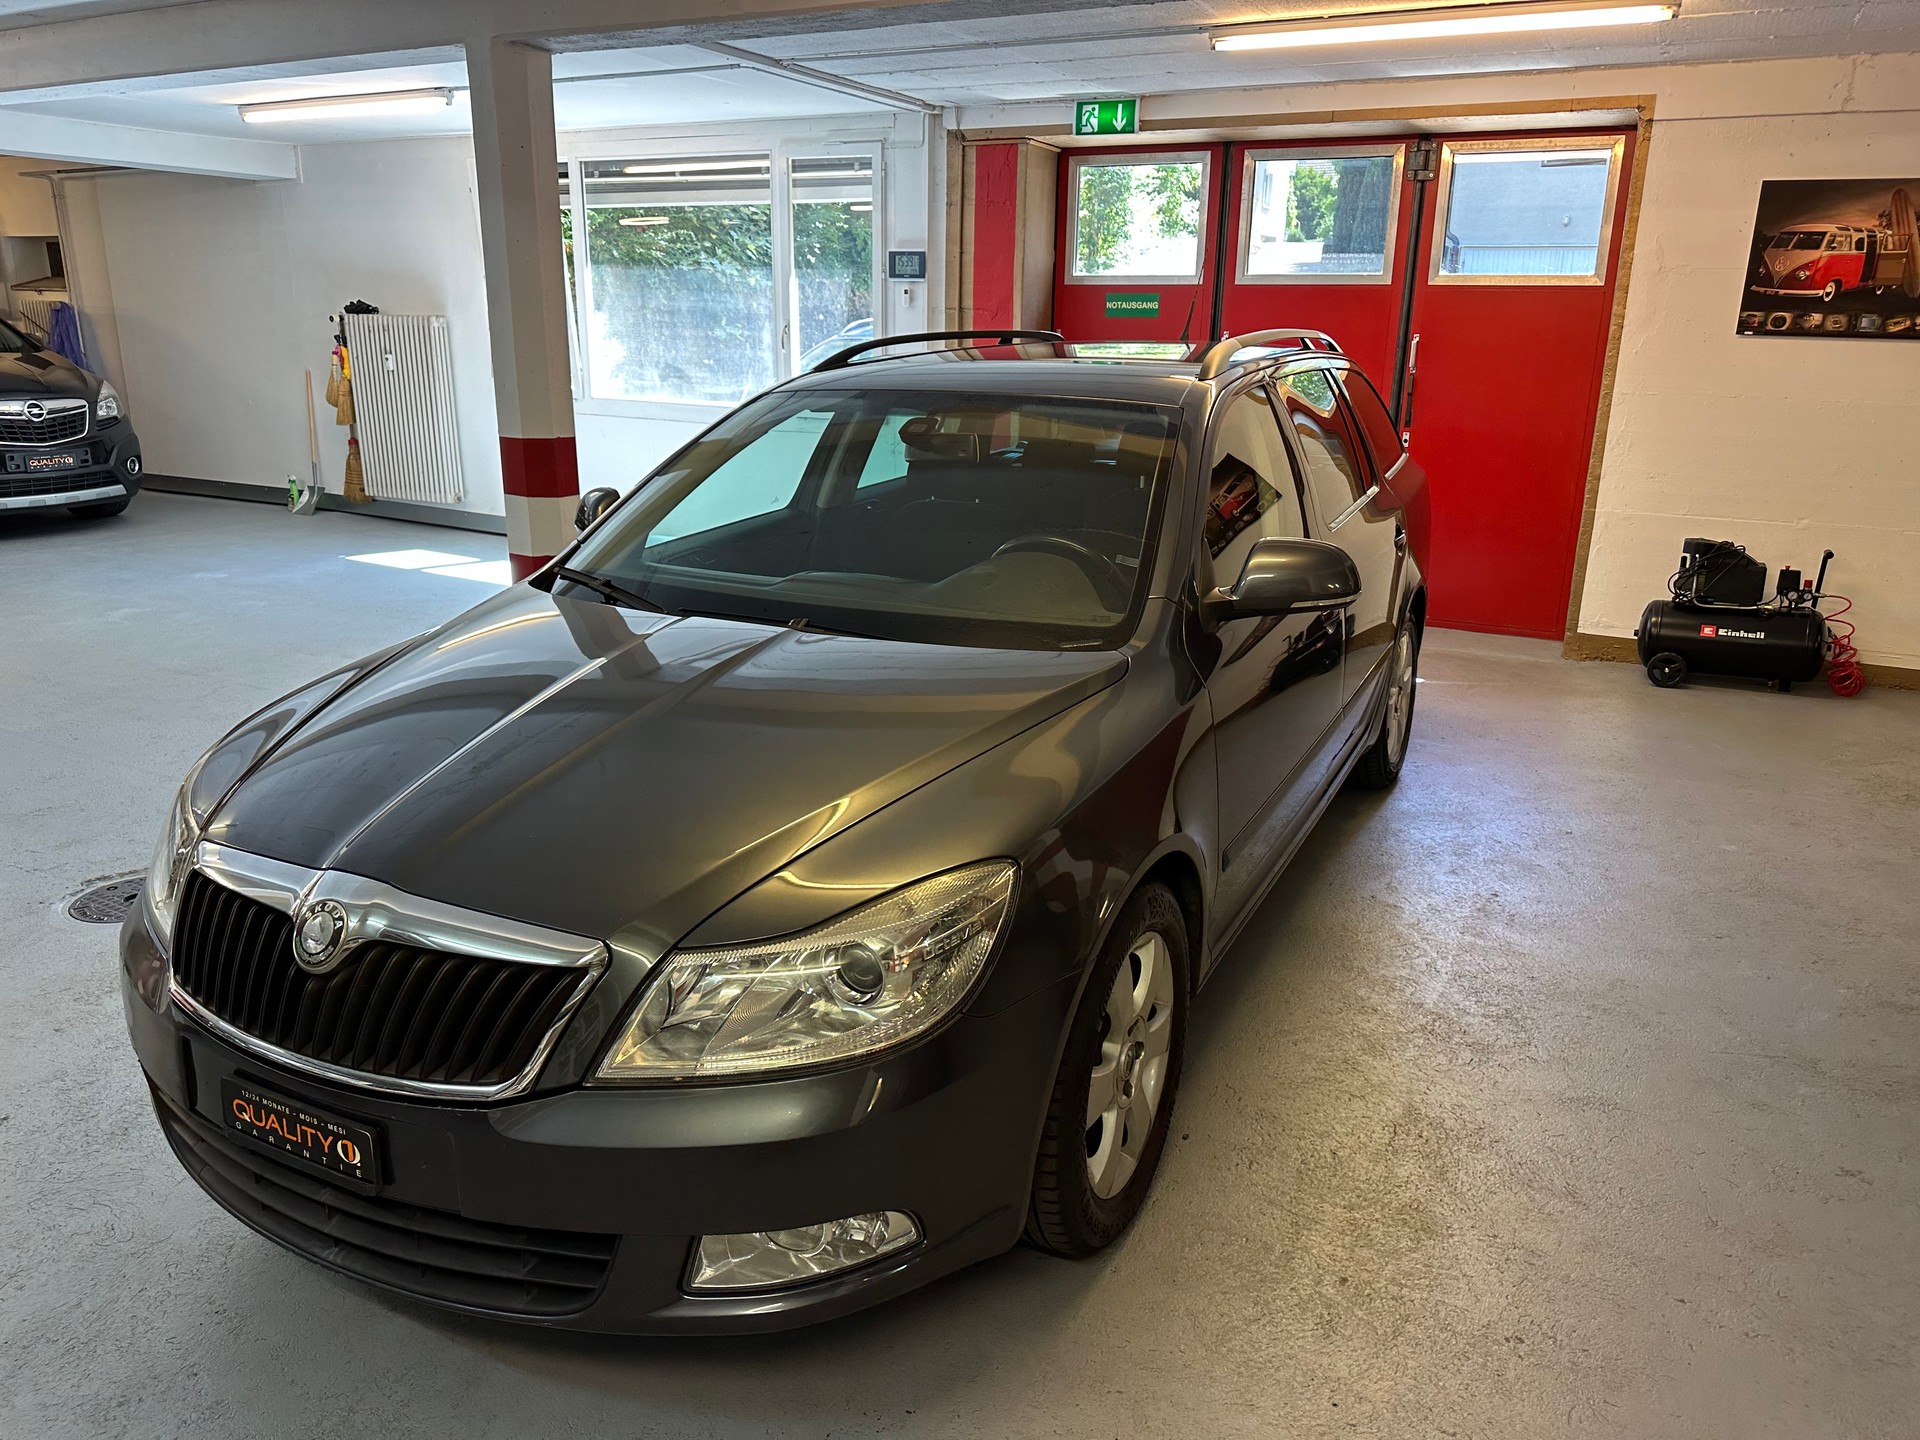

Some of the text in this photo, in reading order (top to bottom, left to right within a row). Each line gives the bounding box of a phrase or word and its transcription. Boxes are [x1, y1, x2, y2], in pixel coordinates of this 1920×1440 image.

[1106, 301, 1159, 309] NOTAUSGANG
[29, 457, 65, 467] QUALITY
[1718, 628, 1765, 639] Einhell
[233, 1099, 334, 1154] QUALITY
[241, 1090, 260, 1102] 12/24
[262, 1098, 290, 1115] MONATE
[299, 1112, 318, 1125] MOIS
[327, 1123, 346, 1135] MESI
[235, 1121, 362, 1178] GARANTIE
